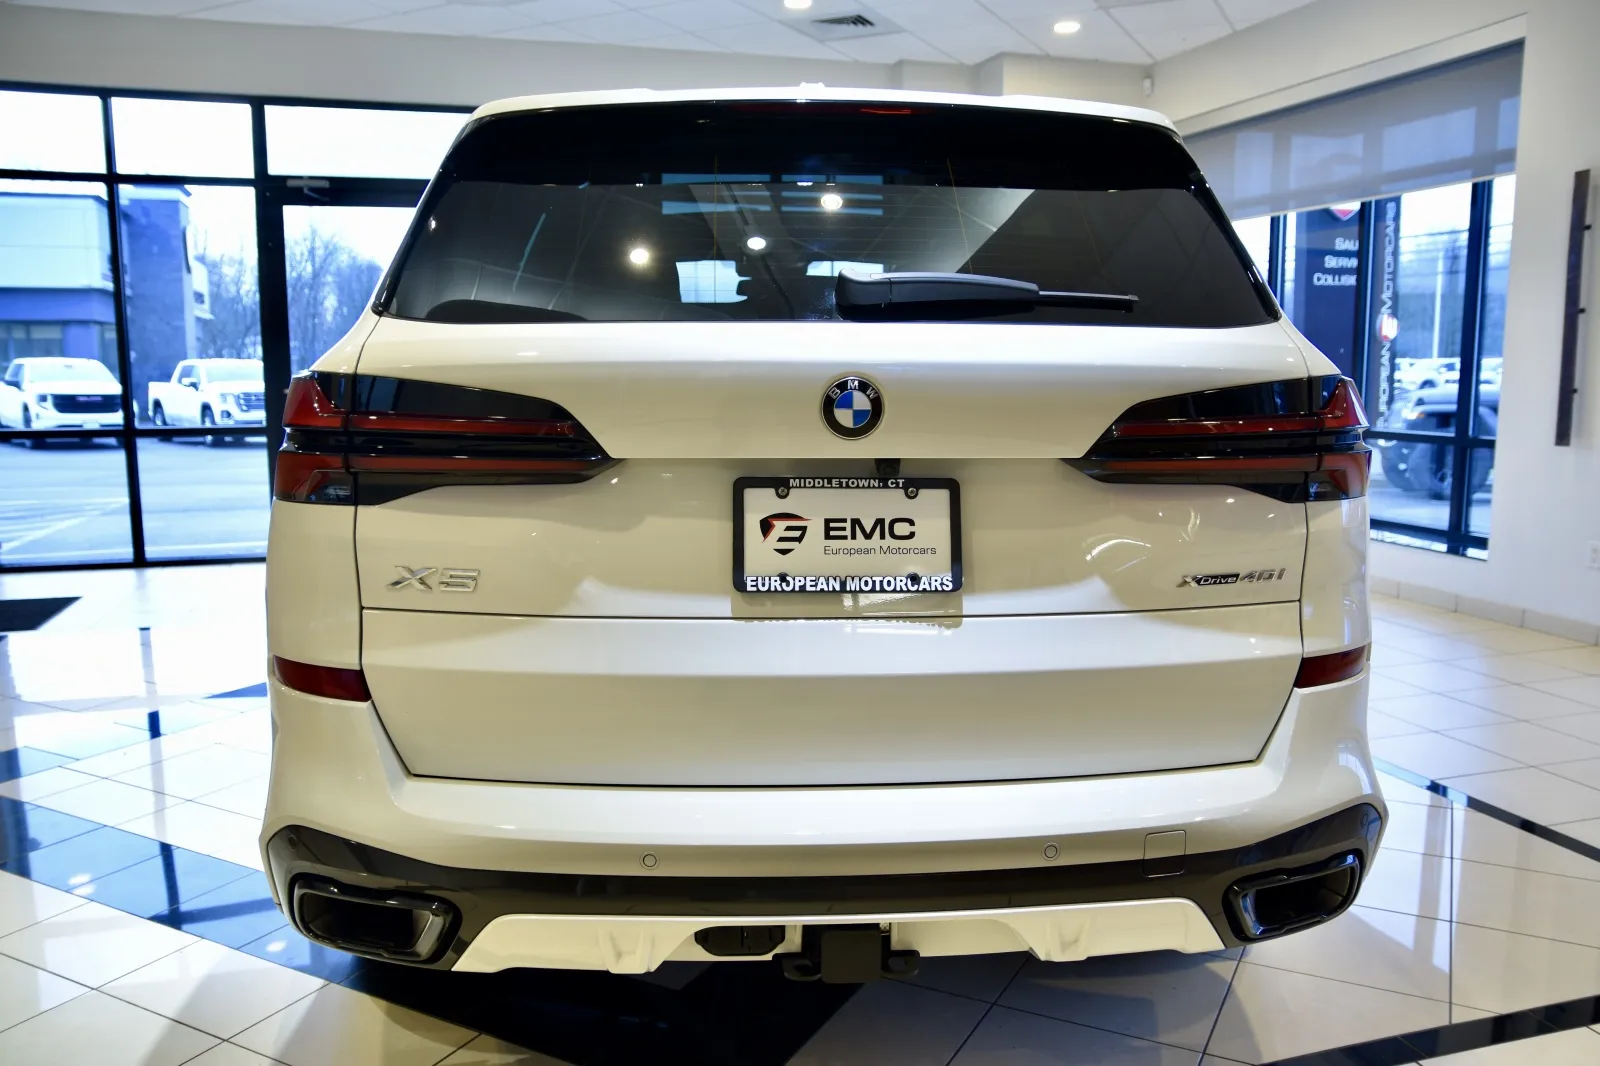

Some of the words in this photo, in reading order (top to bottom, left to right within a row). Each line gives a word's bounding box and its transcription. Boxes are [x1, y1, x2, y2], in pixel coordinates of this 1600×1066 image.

[827, 379, 879, 400] BMW
[789, 478, 884, 489] MIDDLETOWN,
[887, 478, 905, 488] CT
[823, 517, 916, 541] EMC
[823, 545, 876, 557] European
[879, 545, 937, 555] Motorcars
[385, 565, 481, 592] X5
[745, 575, 841, 592] EUROPEAN
[845, 575, 954, 592] MOTORCARS
